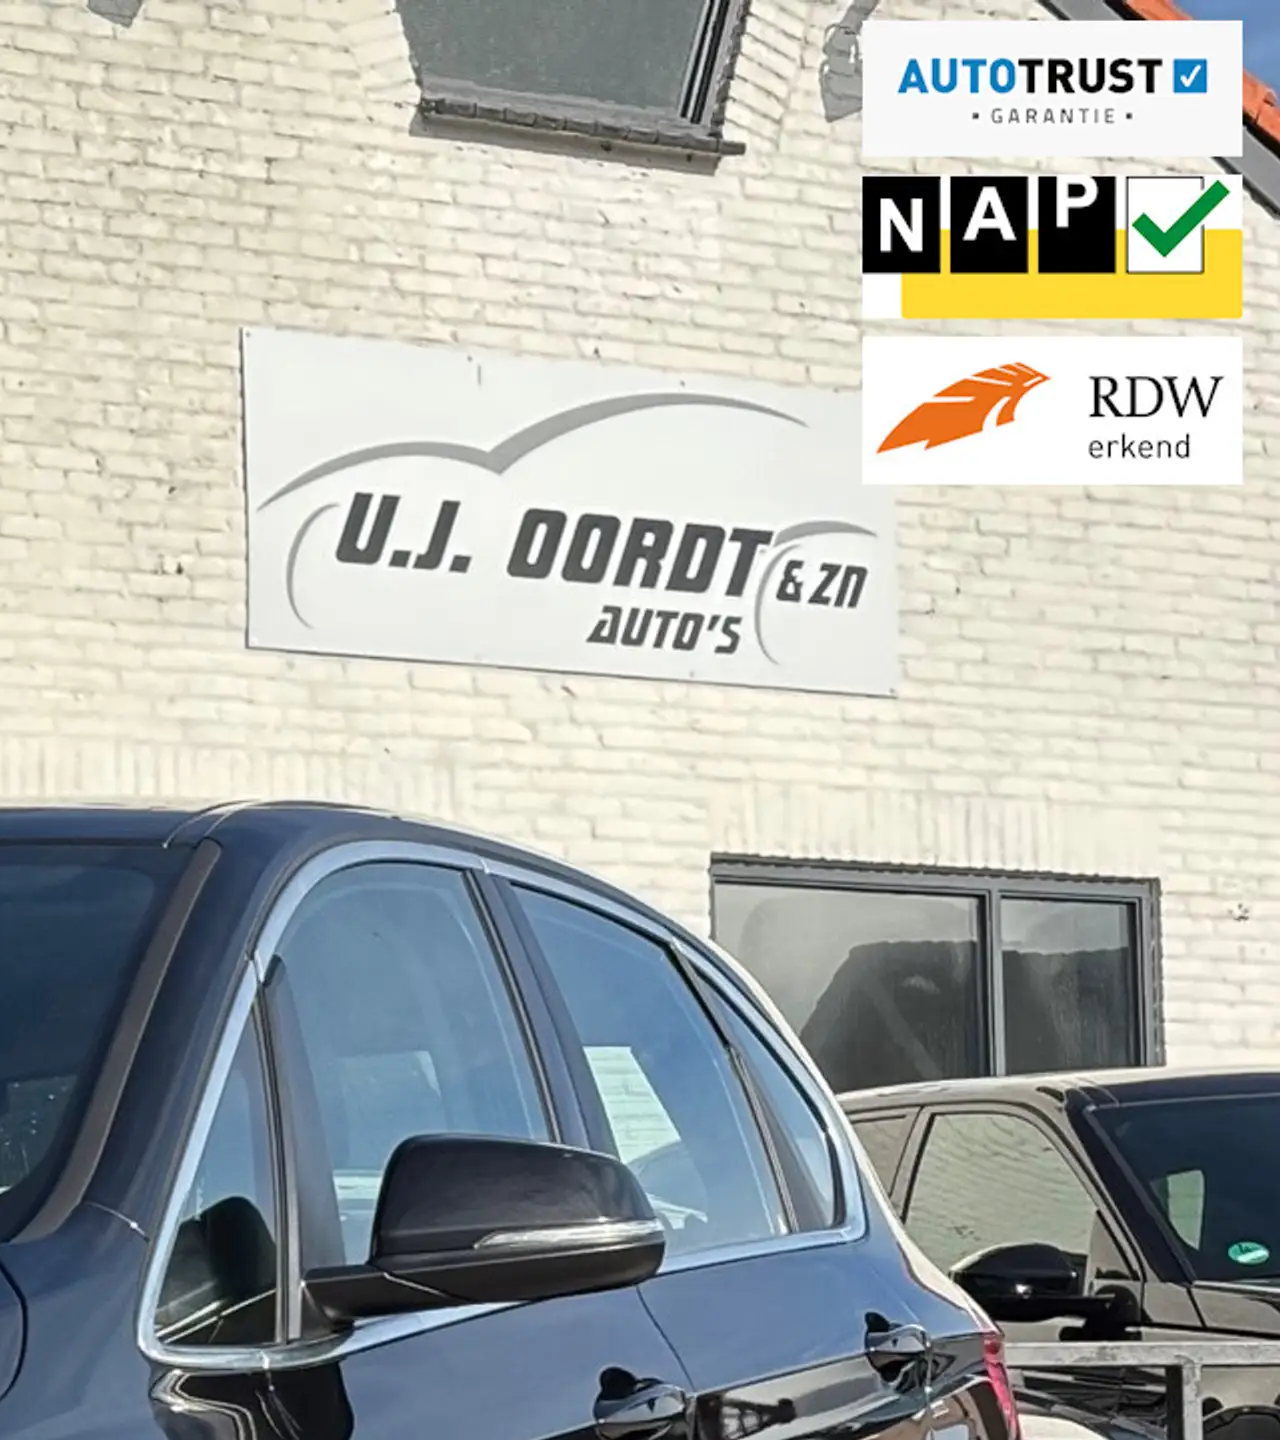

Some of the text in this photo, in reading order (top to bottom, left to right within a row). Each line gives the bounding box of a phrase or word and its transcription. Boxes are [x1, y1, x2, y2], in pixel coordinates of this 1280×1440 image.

[336, 492, 472, 574] U.J.
[507, 509, 774, 597] OORDT
[776, 560, 804, 603] &
